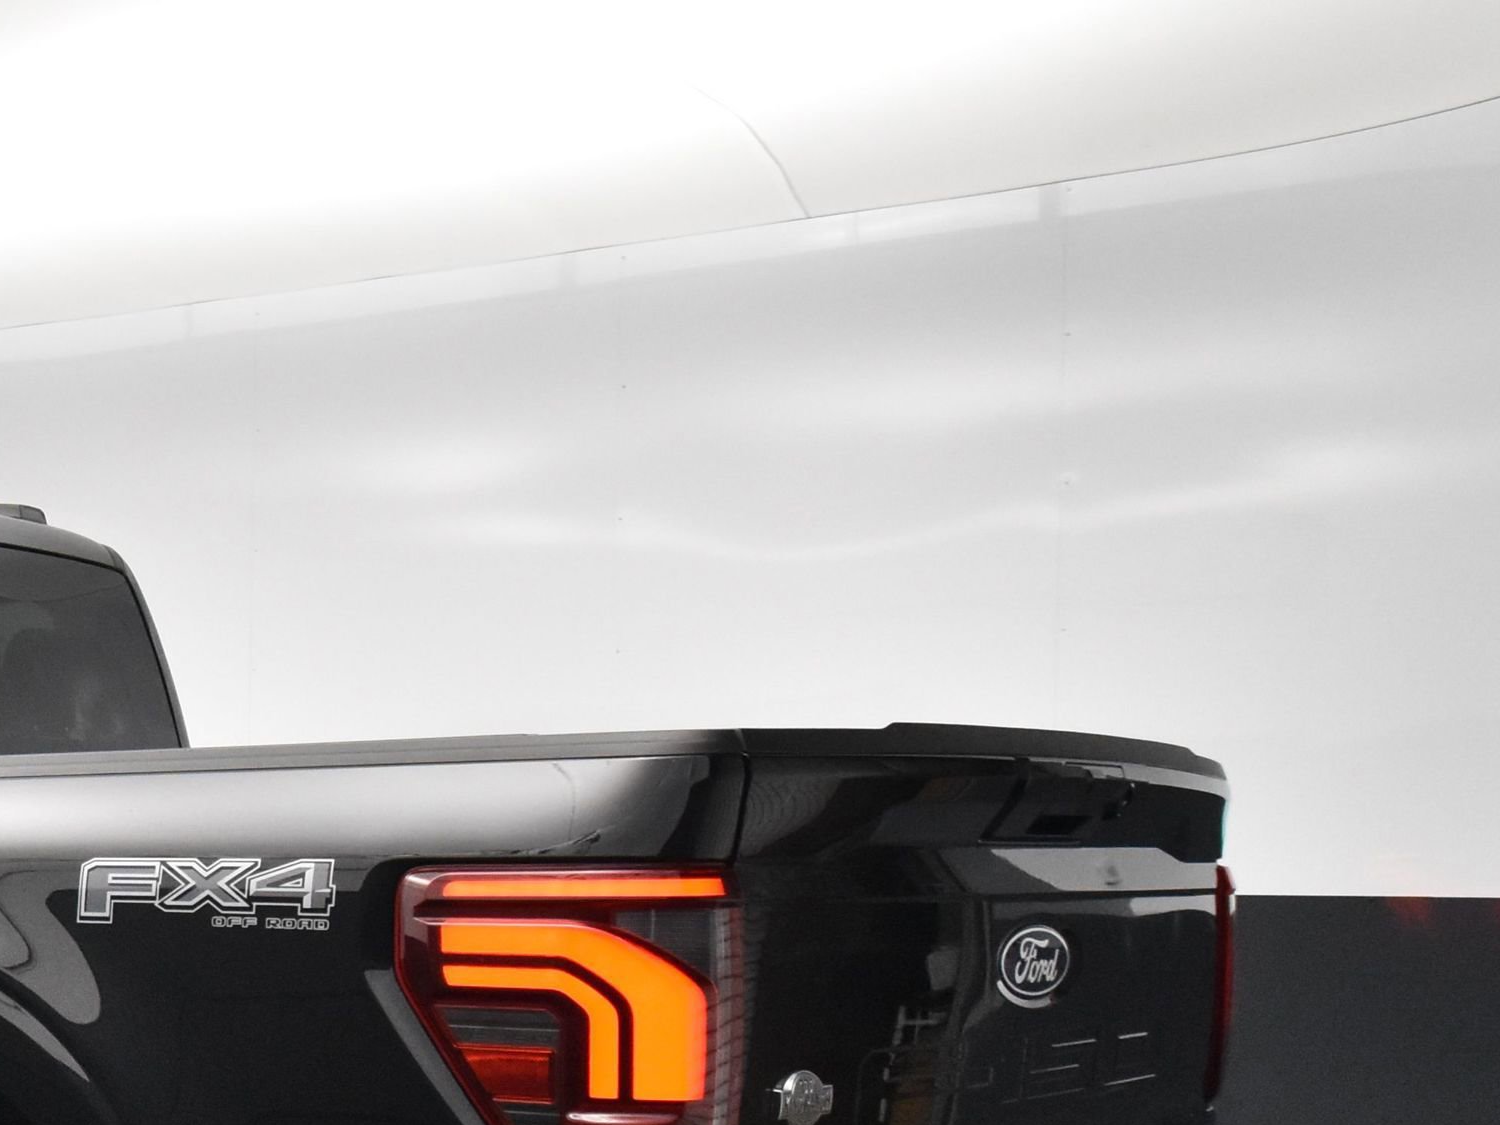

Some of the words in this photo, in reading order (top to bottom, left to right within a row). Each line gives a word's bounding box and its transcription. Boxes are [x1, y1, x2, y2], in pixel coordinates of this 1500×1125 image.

[77, 857, 335, 924] FX4
[211, 916, 258, 928] OFF
[266, 918, 330, 931] ROAD
[1014, 937, 1060, 984] Ford
